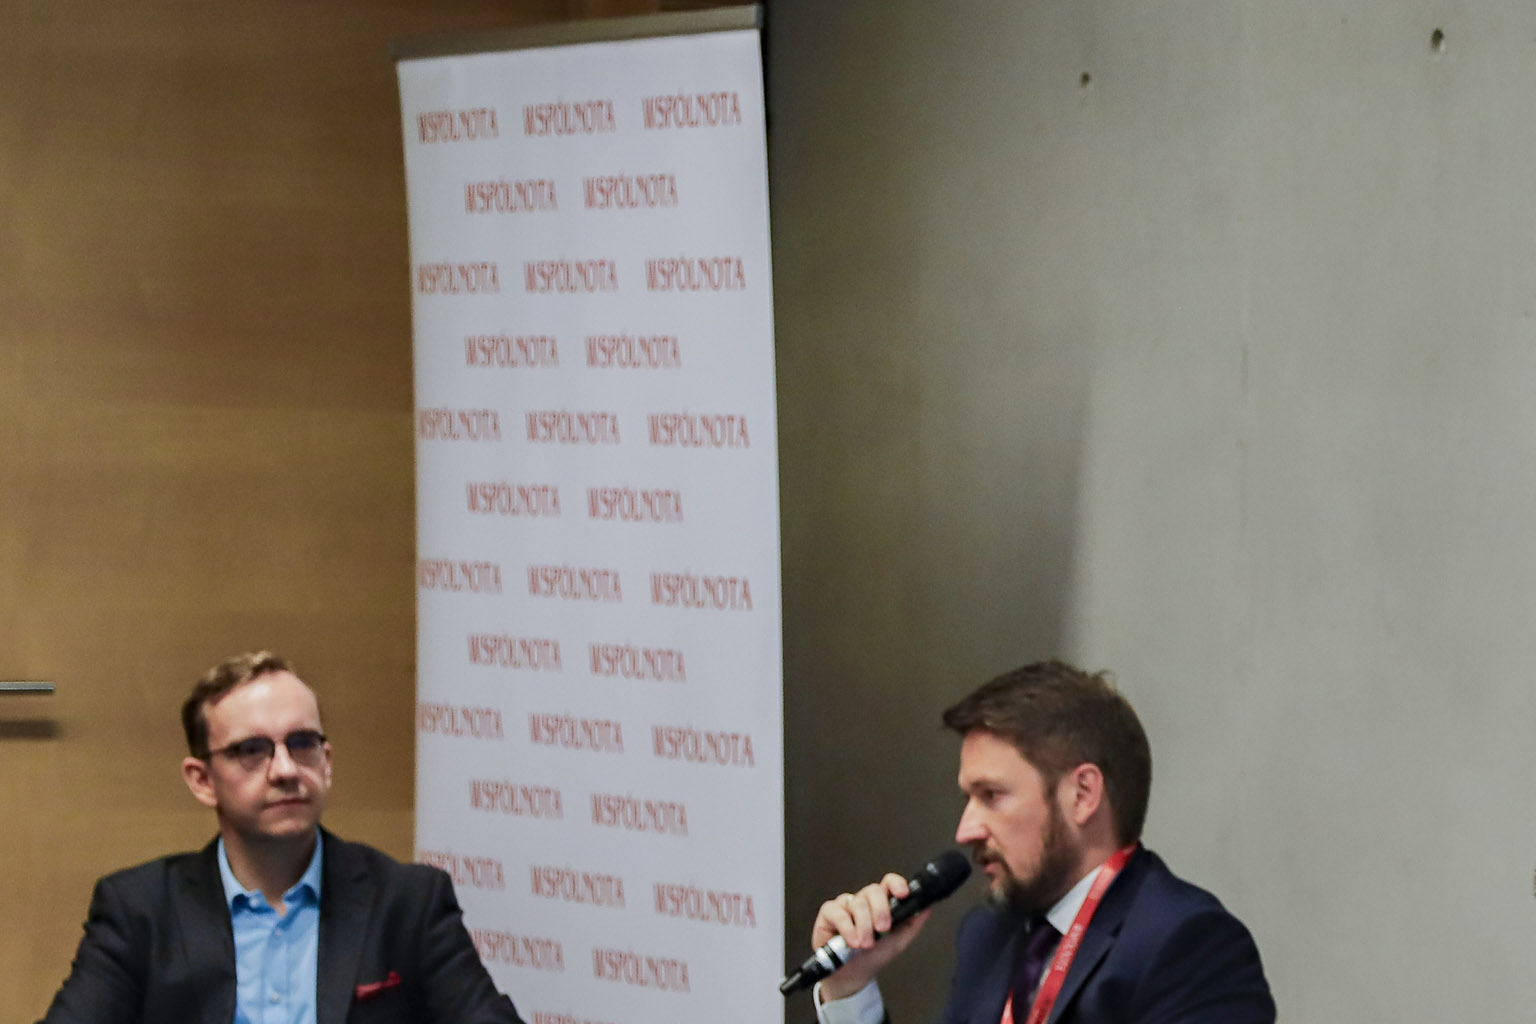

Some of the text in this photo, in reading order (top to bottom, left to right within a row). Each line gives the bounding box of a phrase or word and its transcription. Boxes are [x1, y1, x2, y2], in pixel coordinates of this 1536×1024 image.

[643, 91, 741, 129] WSPÓLNOTA
[646, 255, 745, 291] WSPÓLNOTA
[649, 412, 749, 447] WSPÓLNOTA
[651, 573, 752, 610] WSPÓLNOTA
[653, 726, 755, 766] WSPÓLNOTA
[655, 884, 756, 927] WSPÓLNOTA
